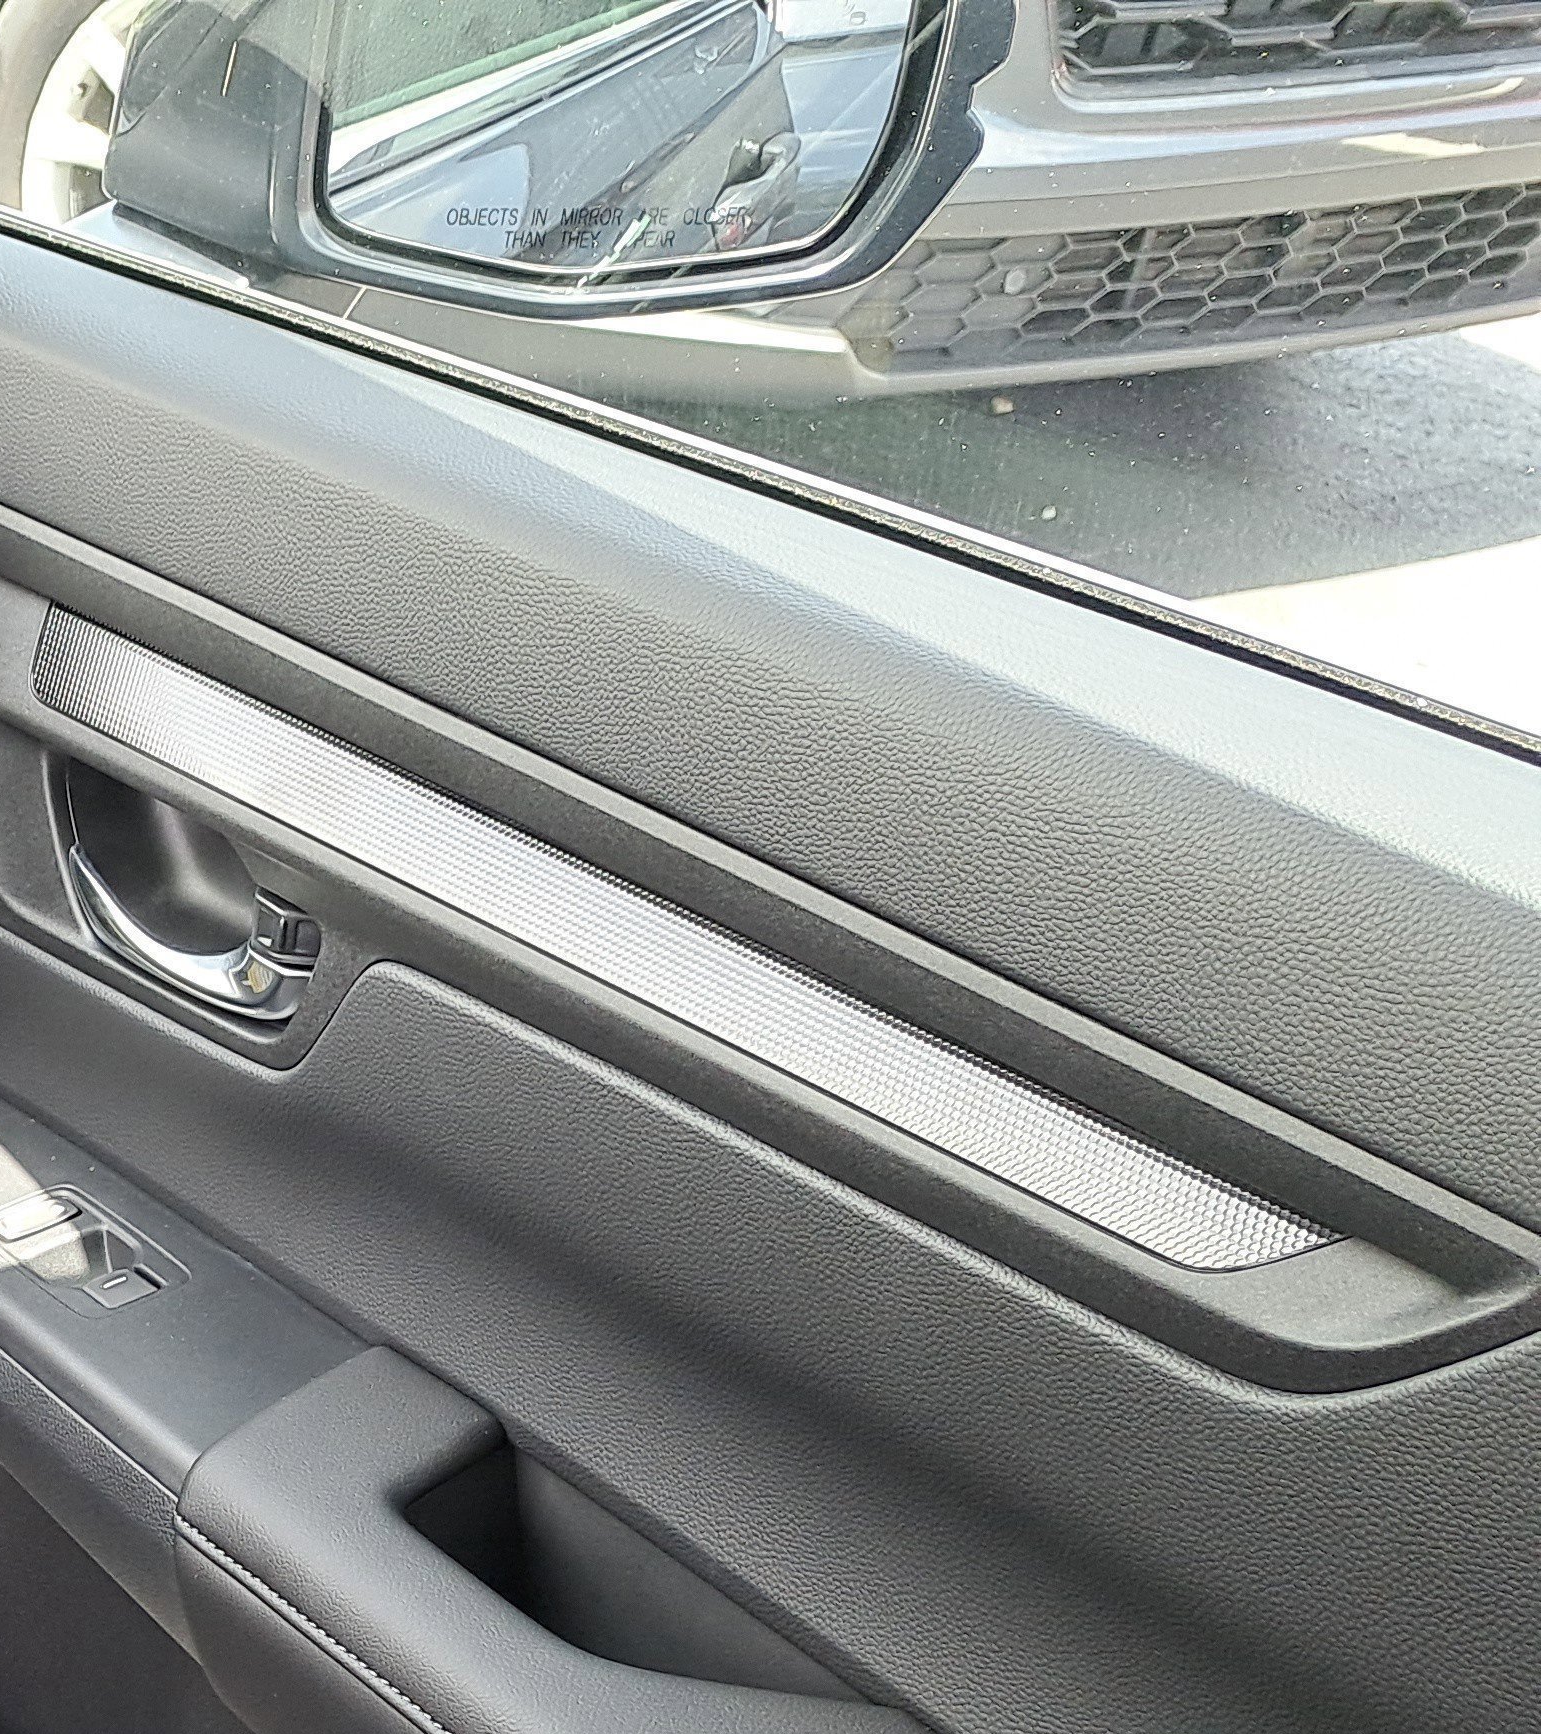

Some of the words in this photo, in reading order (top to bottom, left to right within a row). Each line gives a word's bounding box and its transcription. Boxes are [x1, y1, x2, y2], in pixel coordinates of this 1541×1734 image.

[446, 207, 518, 226] OBJECTS
[530, 207, 548, 226] IN
[560, 206, 623, 226] MIRROR
[504, 230, 546, 249] THAN
[562, 229, 600, 249] THEY
